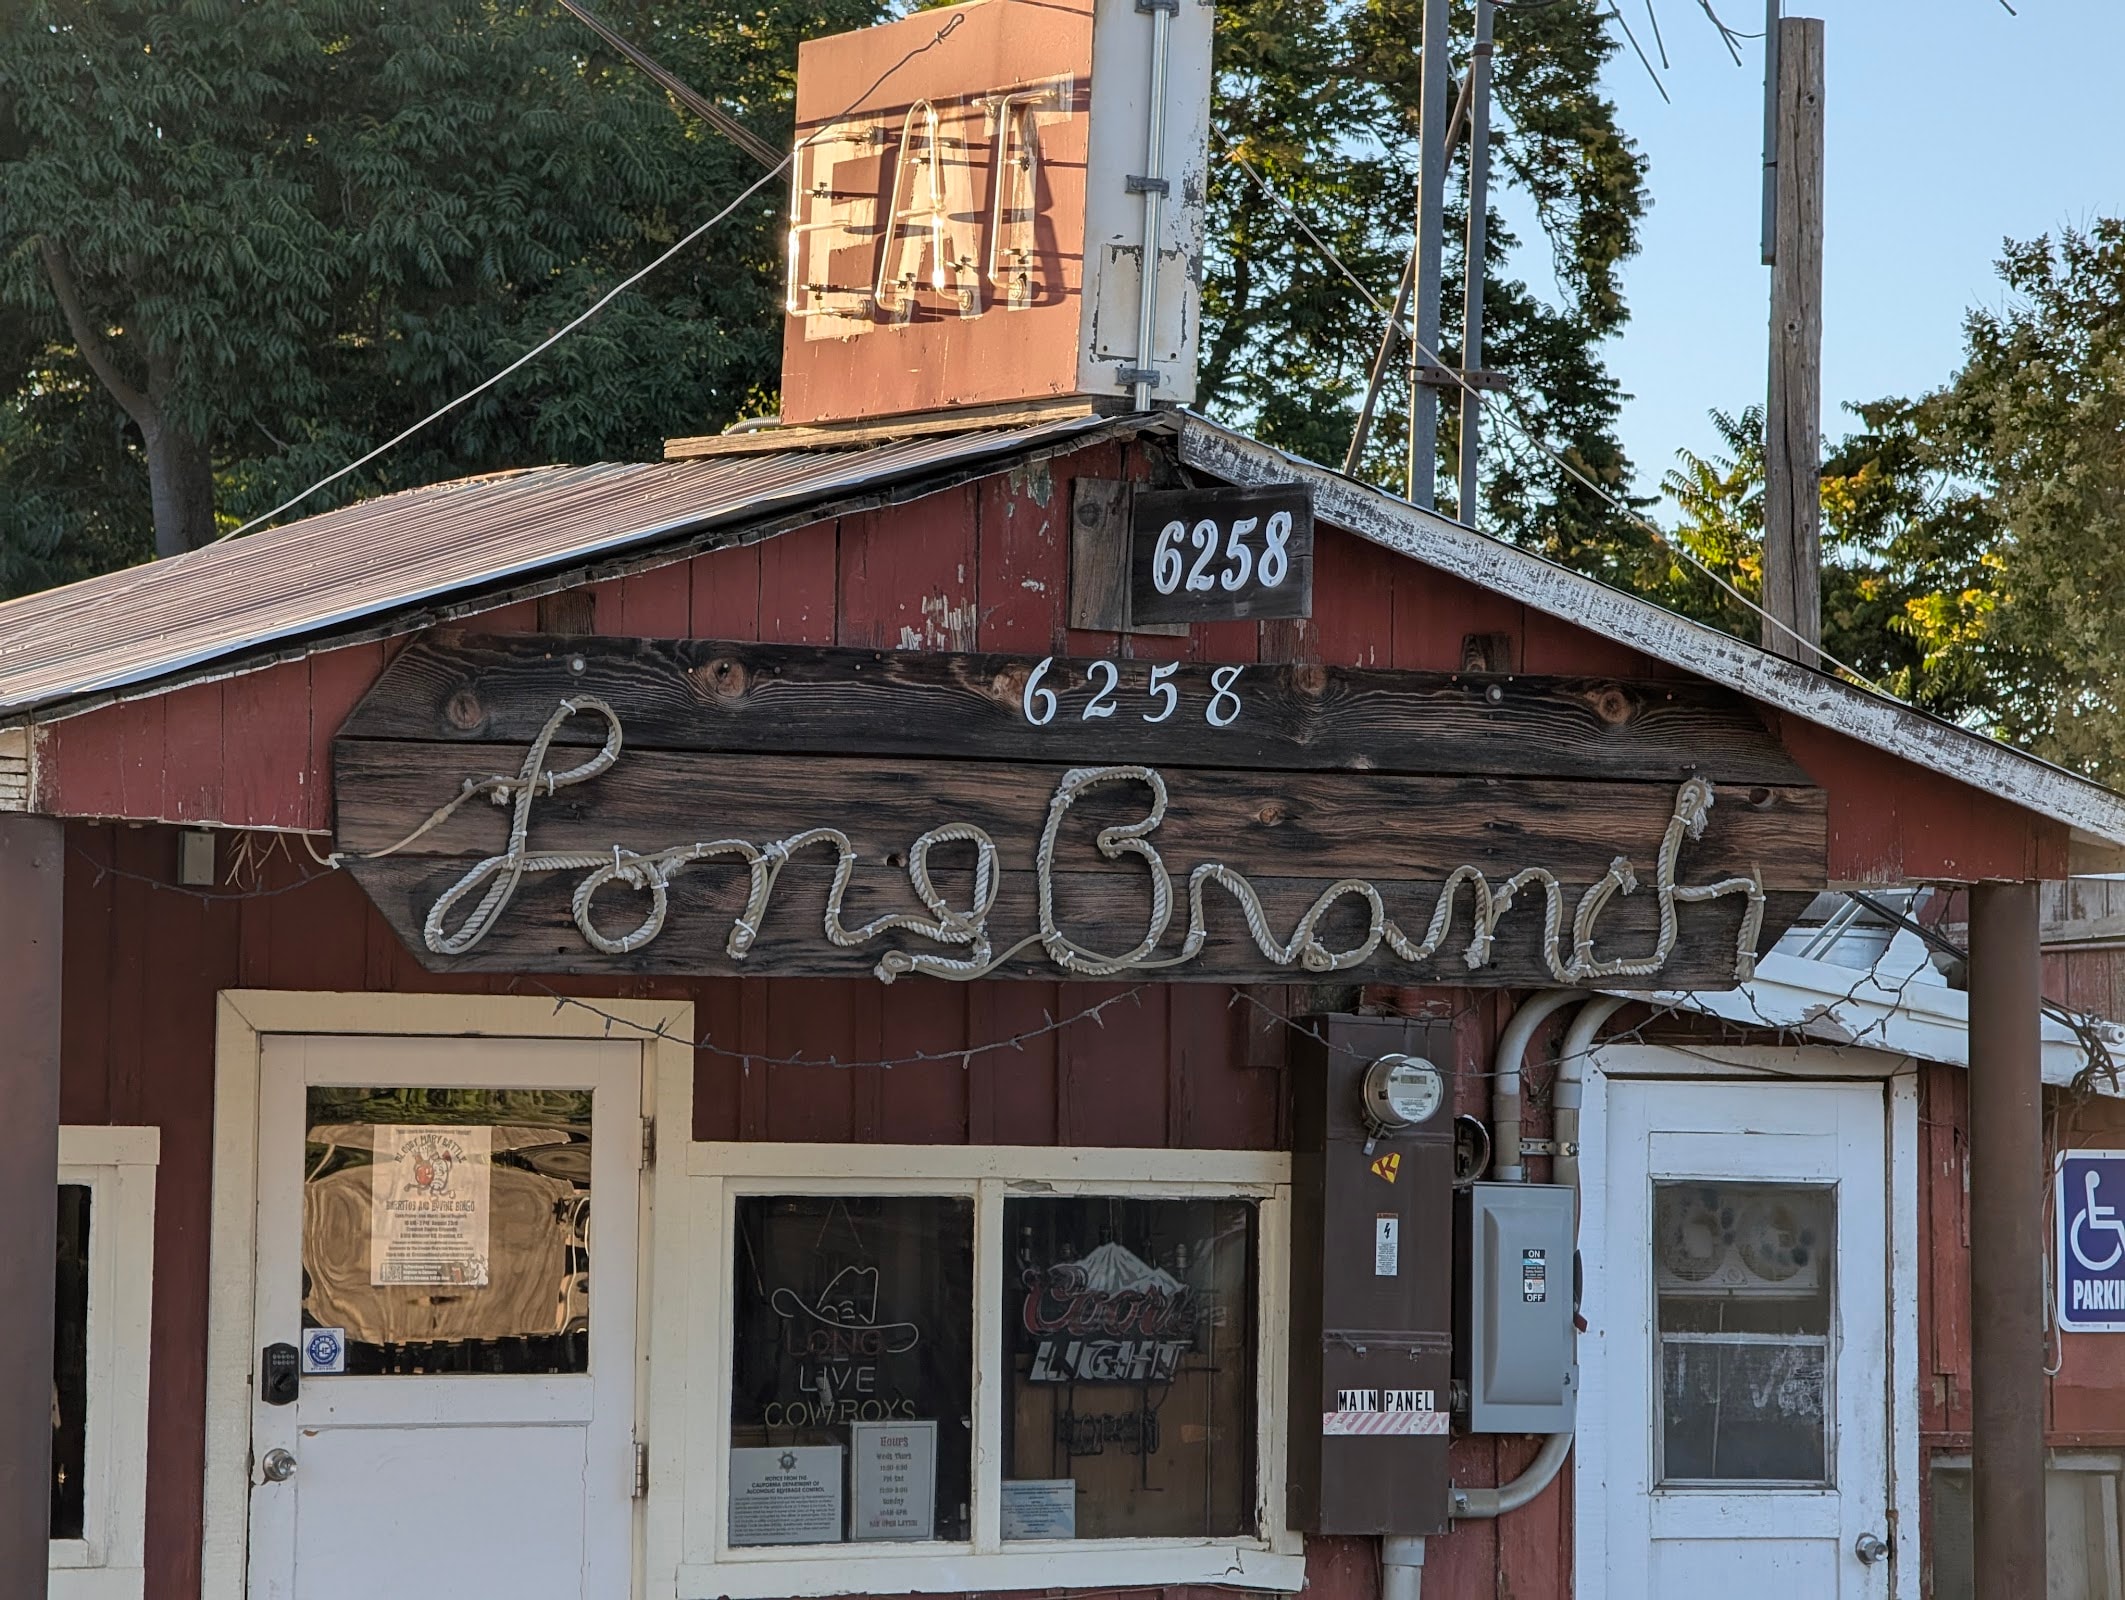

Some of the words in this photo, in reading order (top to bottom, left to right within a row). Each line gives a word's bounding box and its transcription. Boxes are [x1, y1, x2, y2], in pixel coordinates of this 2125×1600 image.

[787, 72, 1074, 341] EAT
[1153, 510, 1292, 595] 6258
[1023, 656, 1243, 726] 6258
[420, 1134, 442, 1146] MARY
[441, 1137, 467, 1163] BATTLE
[455, 1201, 475, 1212] BINGO
[1528, 1250, 1541, 1258] ON
[1527, 1293, 1543, 1302] OFF
[786, 1329, 883, 1356] LONG
[800, 1365, 876, 1393] LIVE
[765, 1399, 916, 1428] COWBOYS
[1339, 1391, 1377, 1411] MAIN
[1386, 1391, 1432, 1411] PANEL
